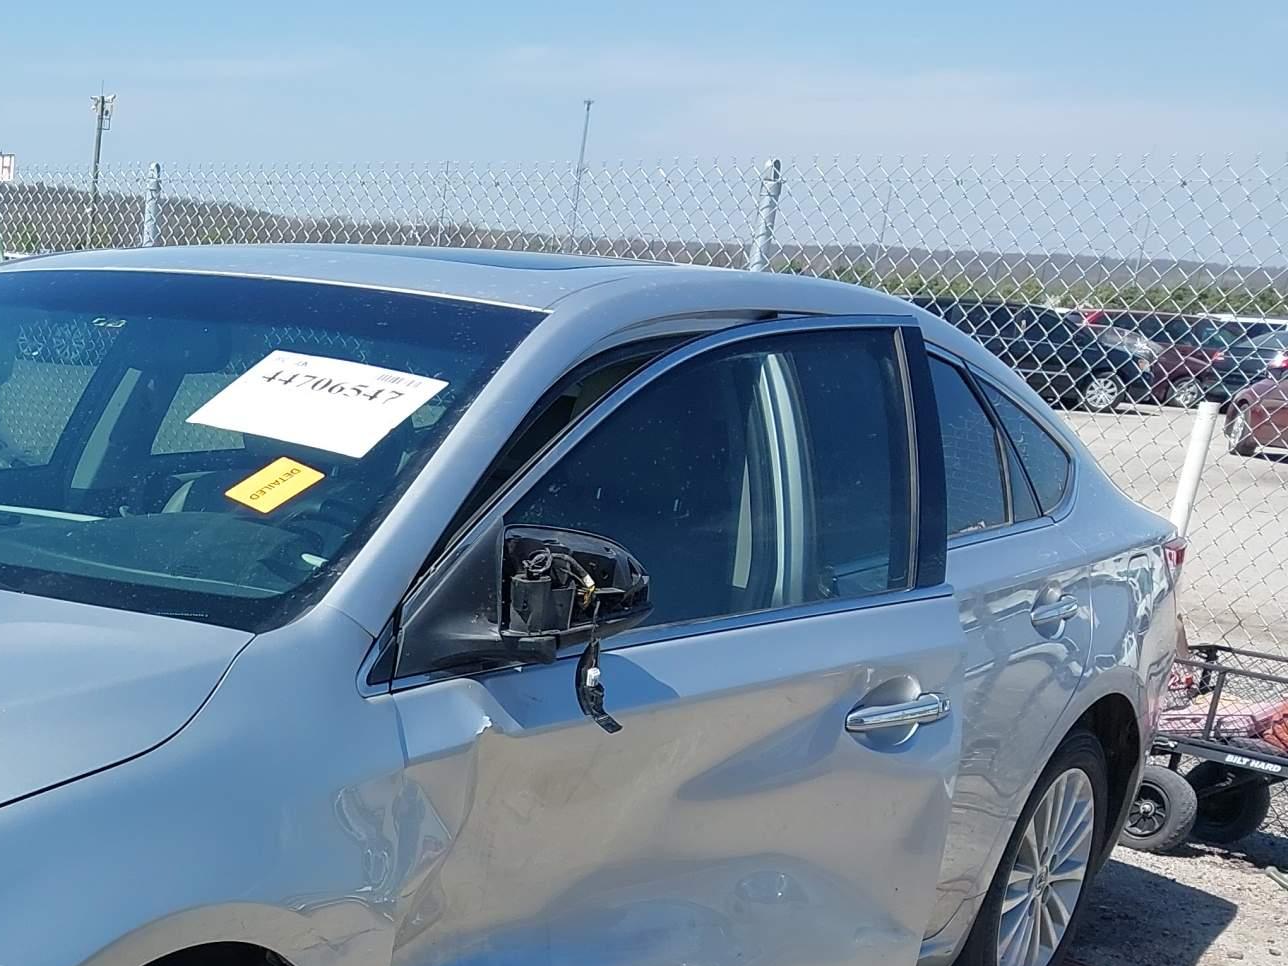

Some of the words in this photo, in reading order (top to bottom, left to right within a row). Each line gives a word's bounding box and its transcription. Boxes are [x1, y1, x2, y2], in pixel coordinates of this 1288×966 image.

[261, 369, 405, 404] 44706547
[249, 467, 302, 501] DETAILED
[1225, 754, 1250, 765] BILT
[1249, 759, 1282, 773] HARD
